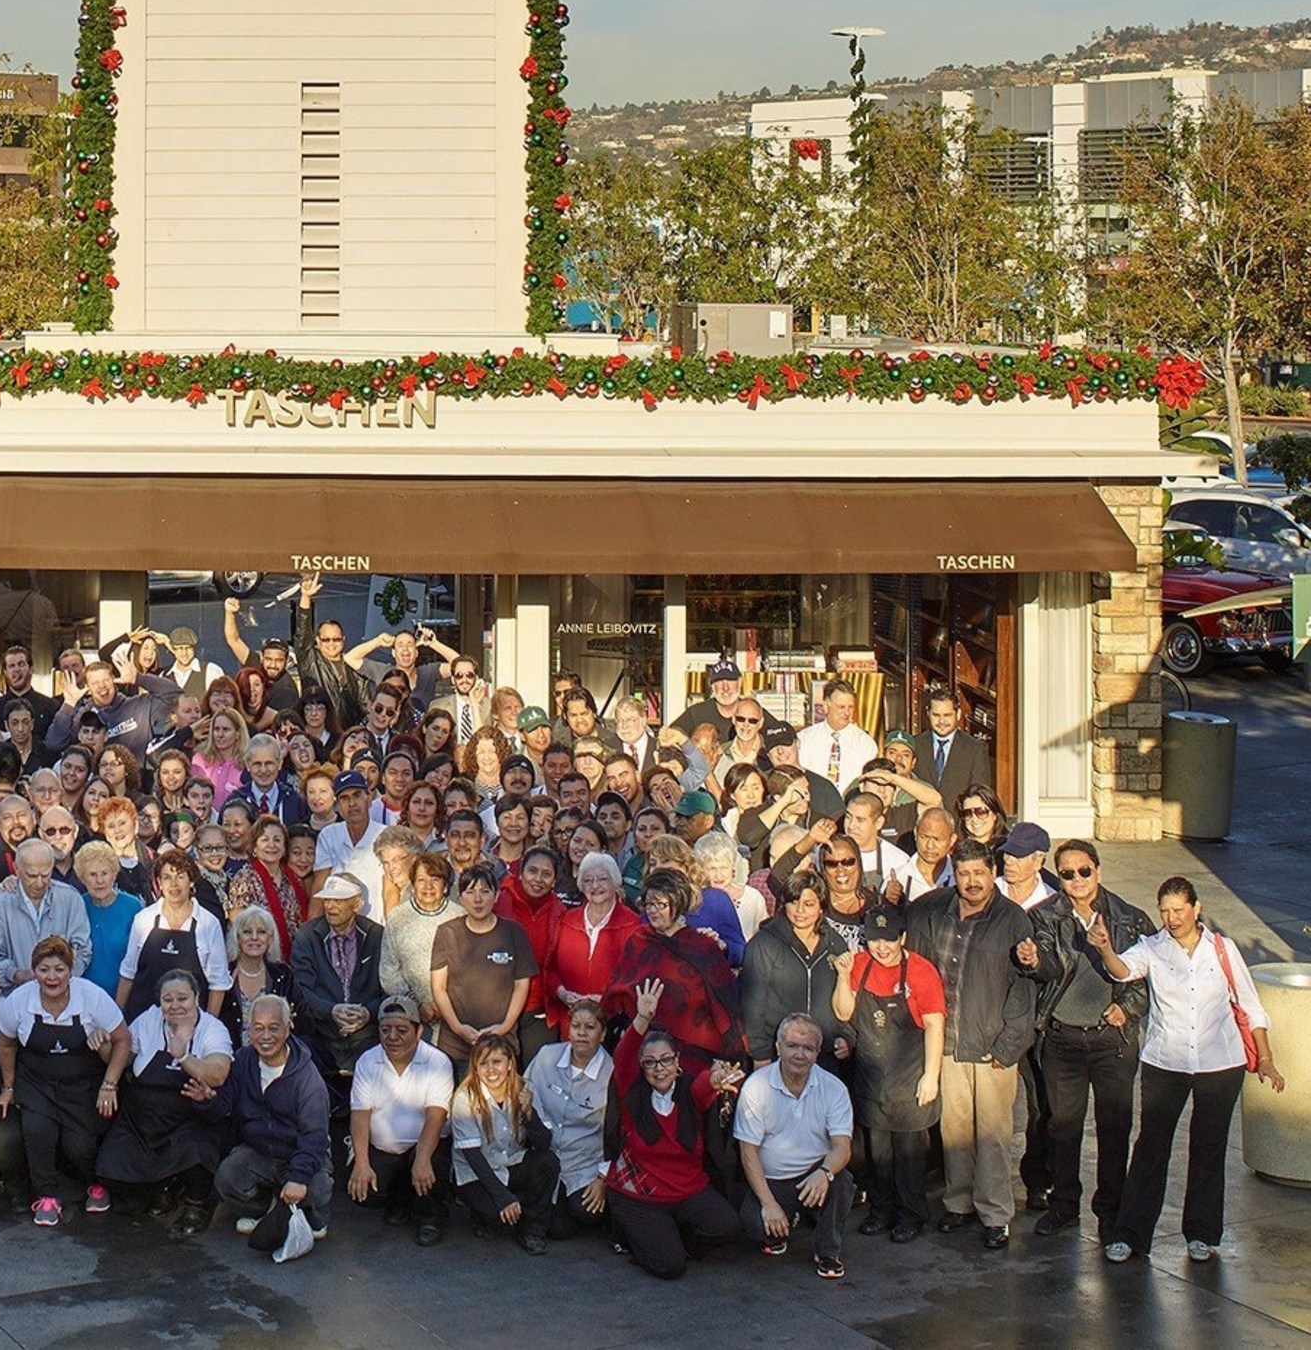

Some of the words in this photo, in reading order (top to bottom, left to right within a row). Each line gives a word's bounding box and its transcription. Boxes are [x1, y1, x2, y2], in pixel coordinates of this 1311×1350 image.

[215, 388, 437, 429] TASCHEN
[291, 555, 370, 570] TASCHEN
[936, 554, 1016, 570] TASCHEN
[556, 622, 594, 634] ANNIE
[596, 623, 657, 635] LEIBOVITZ
